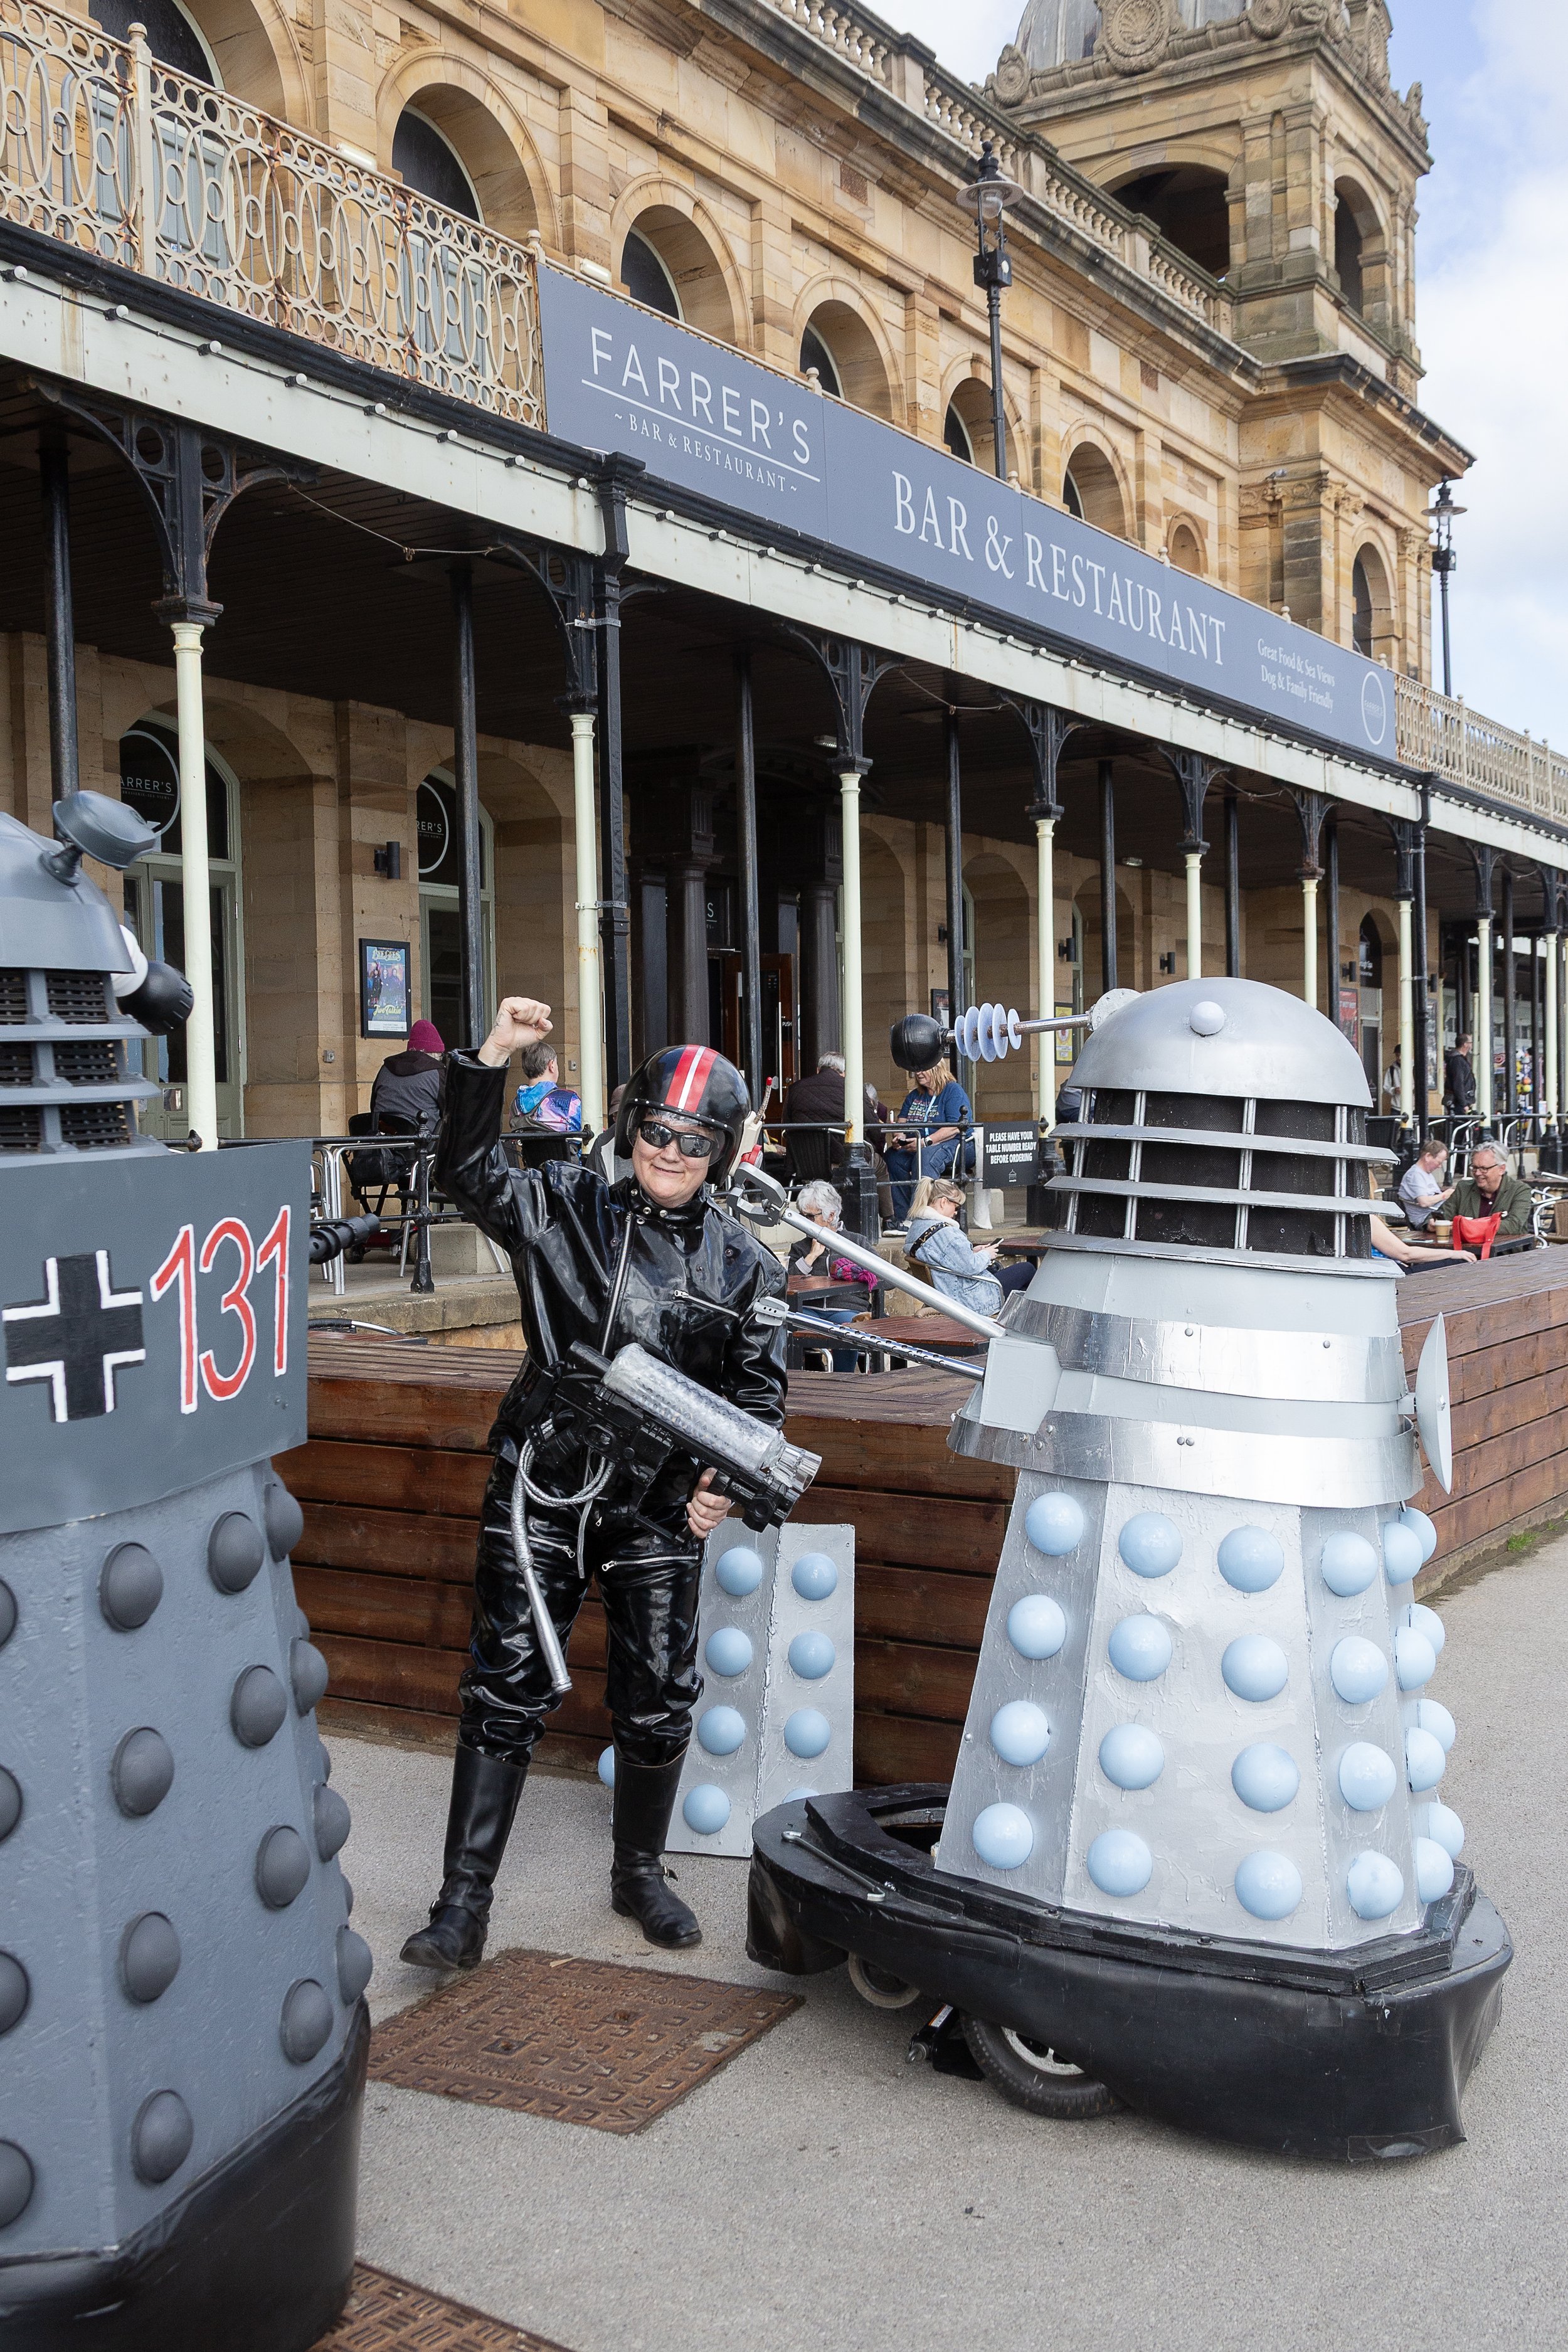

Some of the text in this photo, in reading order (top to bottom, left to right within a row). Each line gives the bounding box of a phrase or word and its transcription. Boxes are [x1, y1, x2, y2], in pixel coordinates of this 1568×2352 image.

[591, 326, 810, 465] FARRER'S
[629, 413, 785, 492] BAR & RESTAURANT
[892, 470, 1226, 665] BAR & RESTAURANT
[1258, 638, 1335, 687] Great Food & Sea Views
[1261, 665, 1334, 714] Dog & Family Friendly
[120, 776, 172, 793] ARRER'S
[416, 820, 442, 833] RER'S
[985, 1142, 1037, 1153] TABLE NUMBER READY
[989, 1131, 1033, 1142] PLEASE HAVE YOUR
[990, 1153, 1032, 1164] BEFORE ORDERING
[150, 1204, 291, 1414] 131
